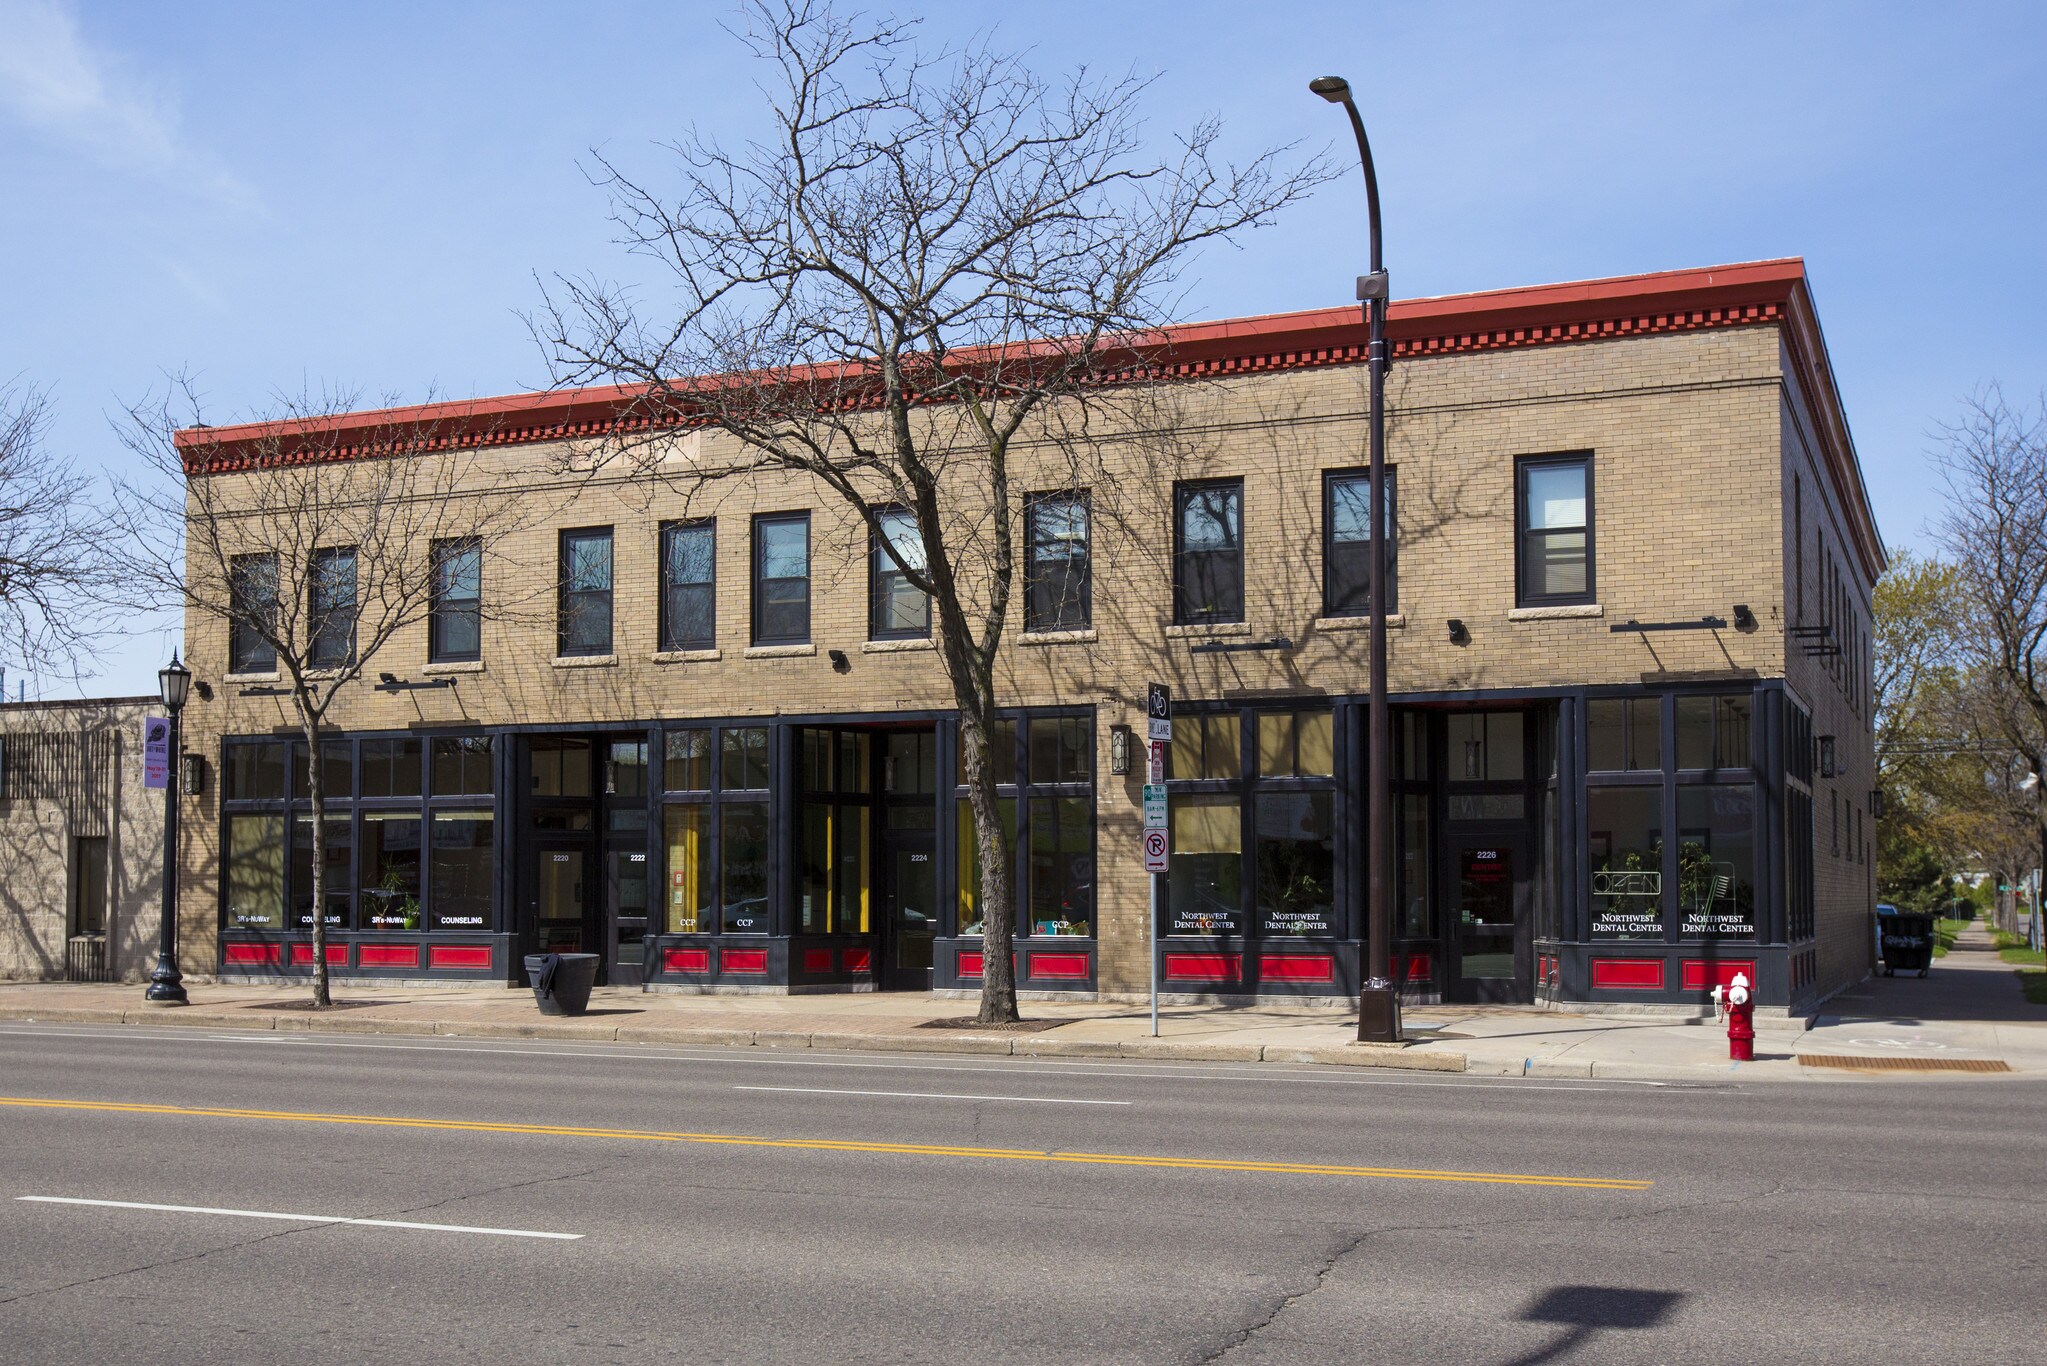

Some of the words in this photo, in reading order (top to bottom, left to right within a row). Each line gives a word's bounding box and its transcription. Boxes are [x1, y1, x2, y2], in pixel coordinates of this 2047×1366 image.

[553, 854, 569, 862] 2220
[1477, 851, 1496, 859] 2226
[1594, 873, 1659, 893] OPEN
[1181, 912, 1228, 920] NORTHWEST
[1272, 912, 1320, 920] NORTHWEST
[1601, 913, 1655, 922] NORTHWEST
[1688, 914, 1744, 923] NORTHWEST
[737, 919, 753, 927] CCP
[1174, 920, 1204, 928] DENTAL
[1205, 920, 1235, 929] CENTER
[1265, 921, 1295, 929] DENTAL
[1592, 923, 1627, 932] DENTAL
[1629, 923, 1663, 932] CENTER
[1682, 923, 1717, 932] DENTAL
[1719, 923, 1754, 932] CENTER
